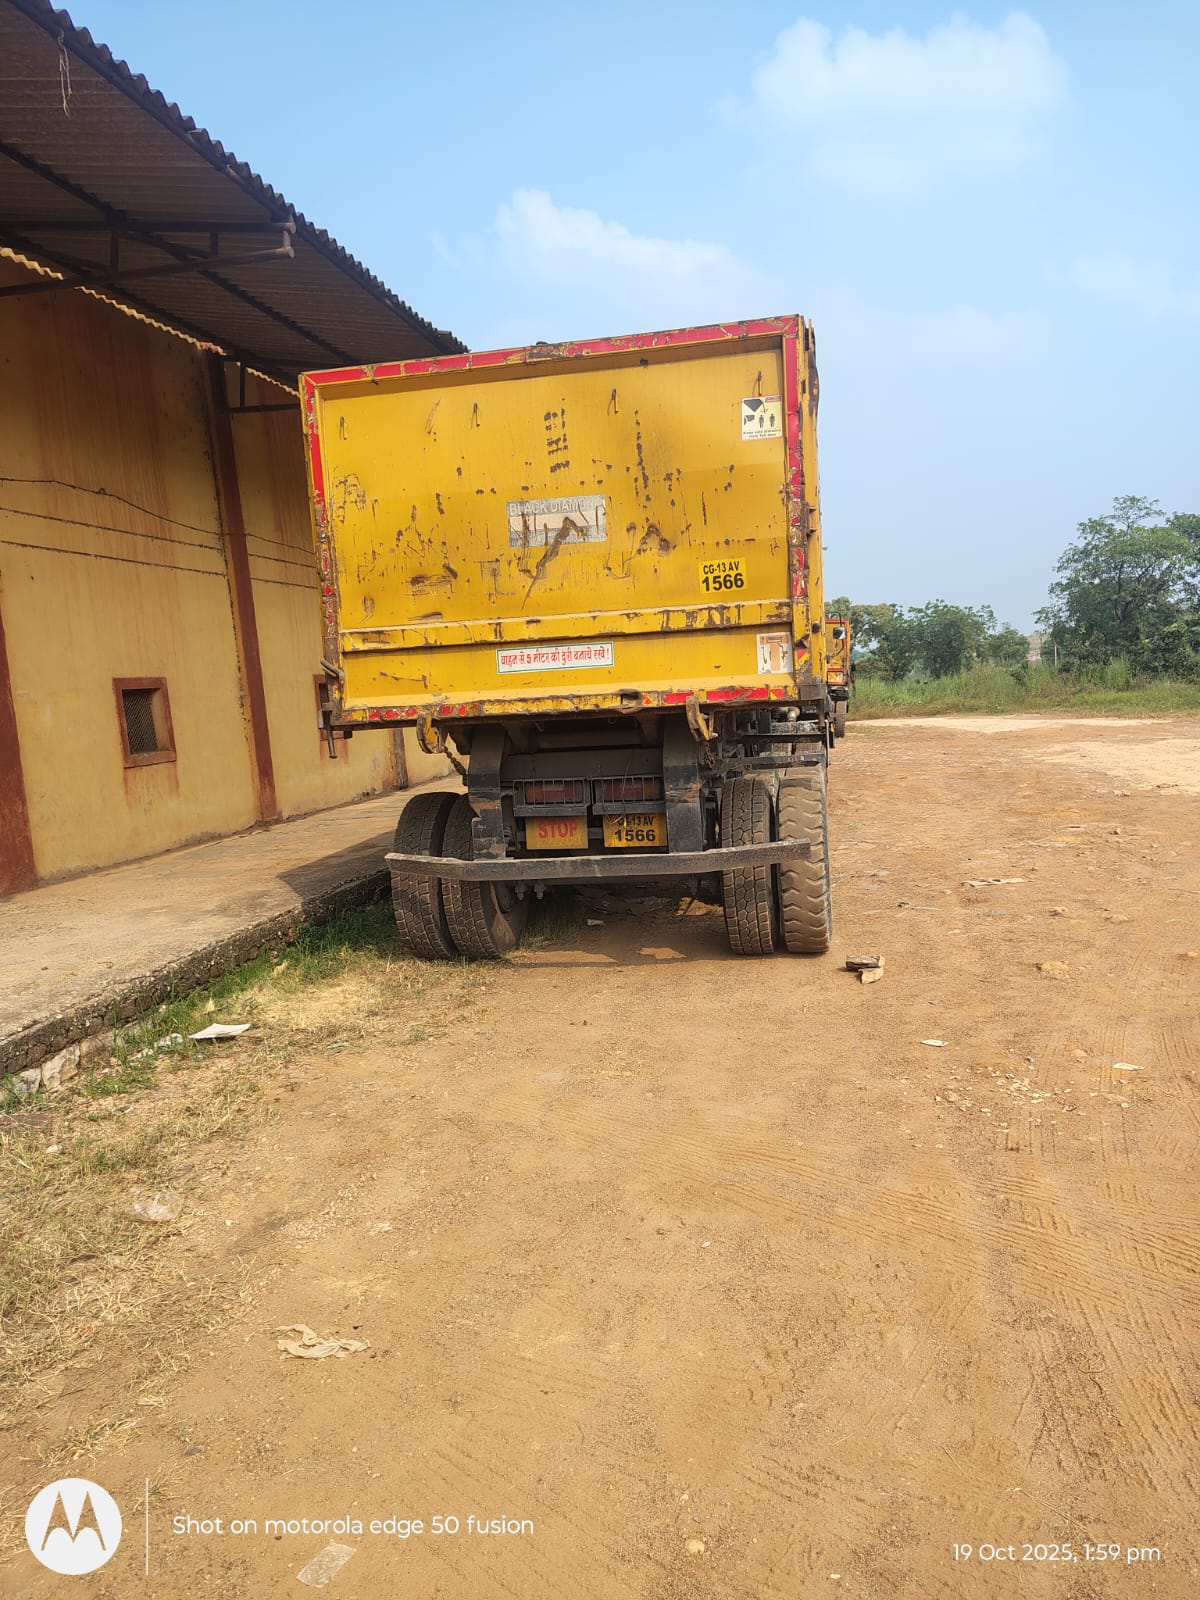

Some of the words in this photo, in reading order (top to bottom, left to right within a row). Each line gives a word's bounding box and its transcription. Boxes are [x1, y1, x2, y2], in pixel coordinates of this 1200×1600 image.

[510, 501, 548, 516] BLACK
[703, 562, 727, 575] CG-13
[728, 560, 740, 572] AV
[702, 572, 744, 592] 1566
[500, 654, 518, 668] वाहन
[526, 653, 532, 665] 5
[550, 648, 560, 662] की
[643, 814, 655, 827] AV
[537, 819, 578, 839] STOP
[613, 828, 656, 842] 1566
